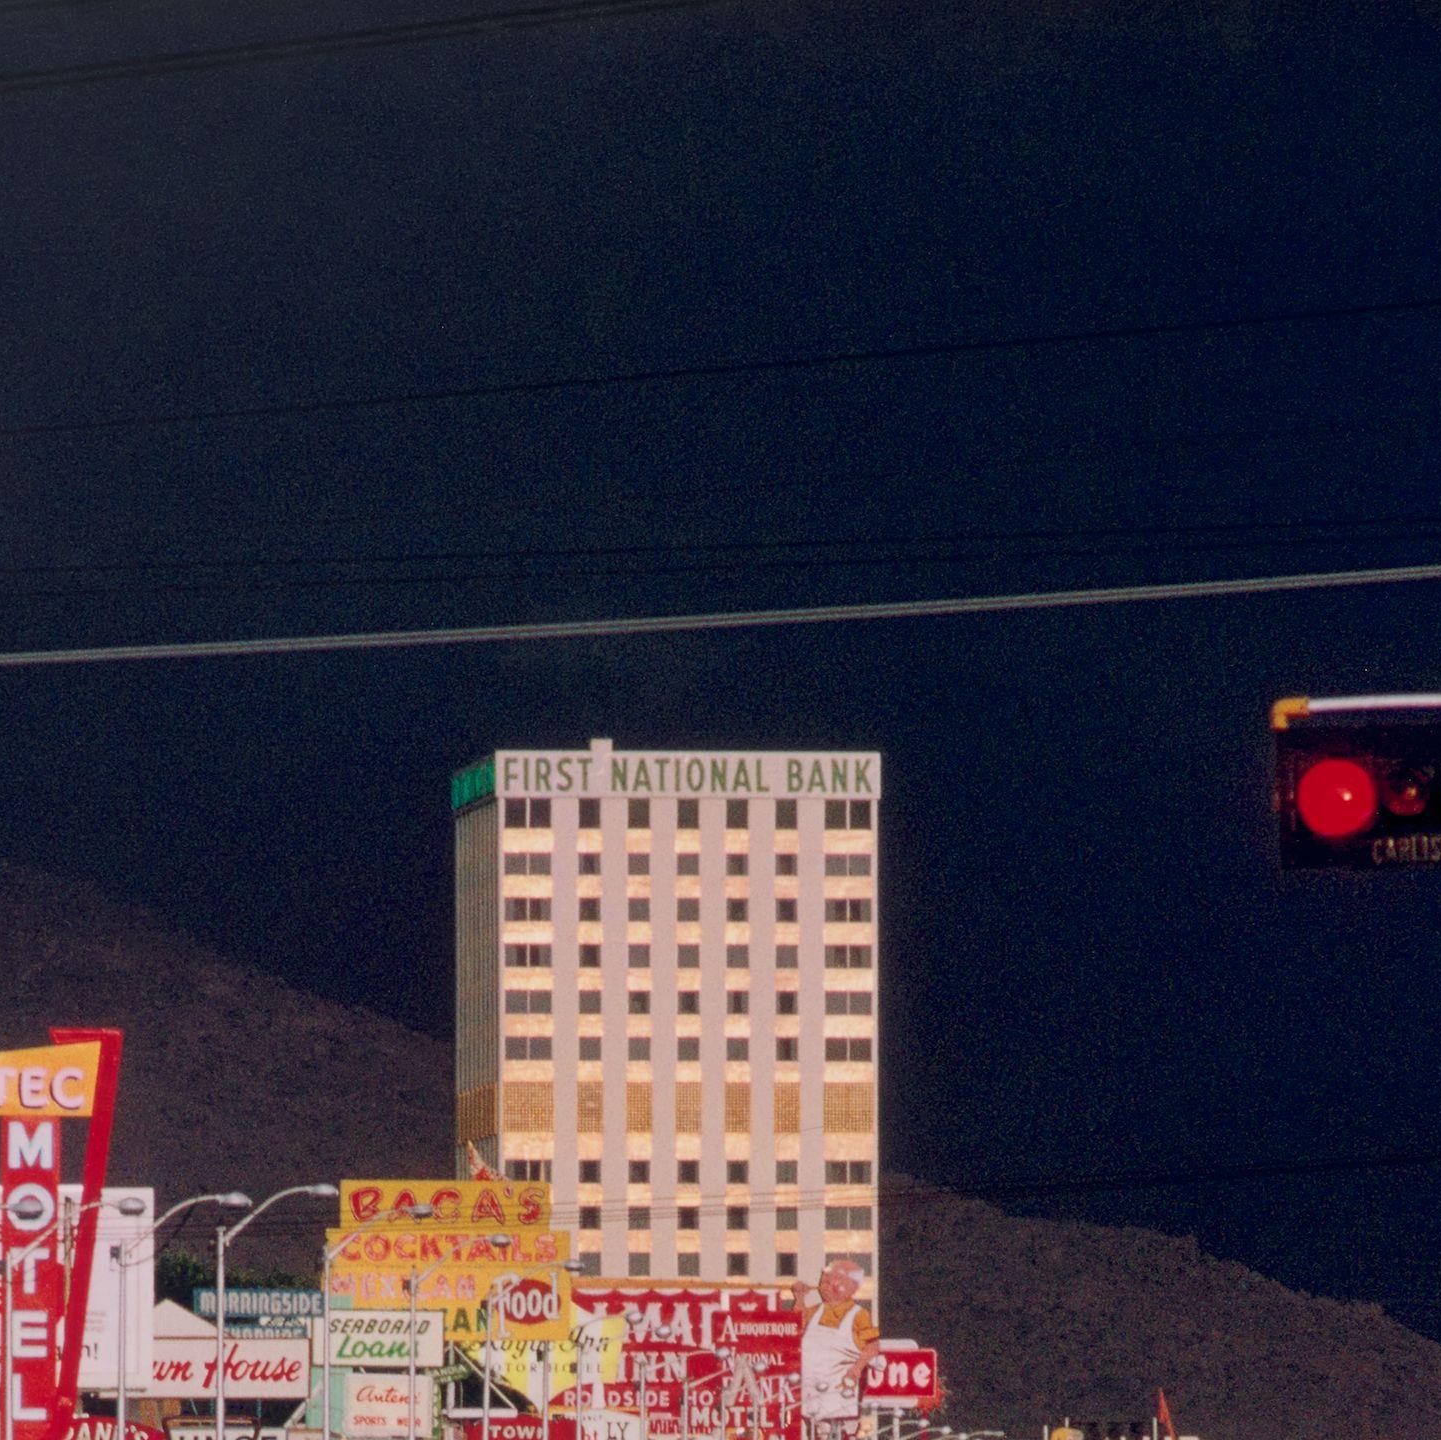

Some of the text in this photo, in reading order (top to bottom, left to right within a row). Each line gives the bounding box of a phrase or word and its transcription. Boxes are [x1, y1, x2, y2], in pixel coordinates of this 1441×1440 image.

[503, 757, 873, 793] FIRST NATIONAL BANK
[349, 1184, 546, 1225] BACA'S
[338, 1232, 559, 1263] COCKTAILS
[7, 1121, 55, 1422] MOTEL
[328, 1317, 430, 1335] SEABOARD
[202, 1341, 302, 1388] House
[563, 1390, 670, 1407] RODSIDE
[396, 1416, 421, 1428] WER
